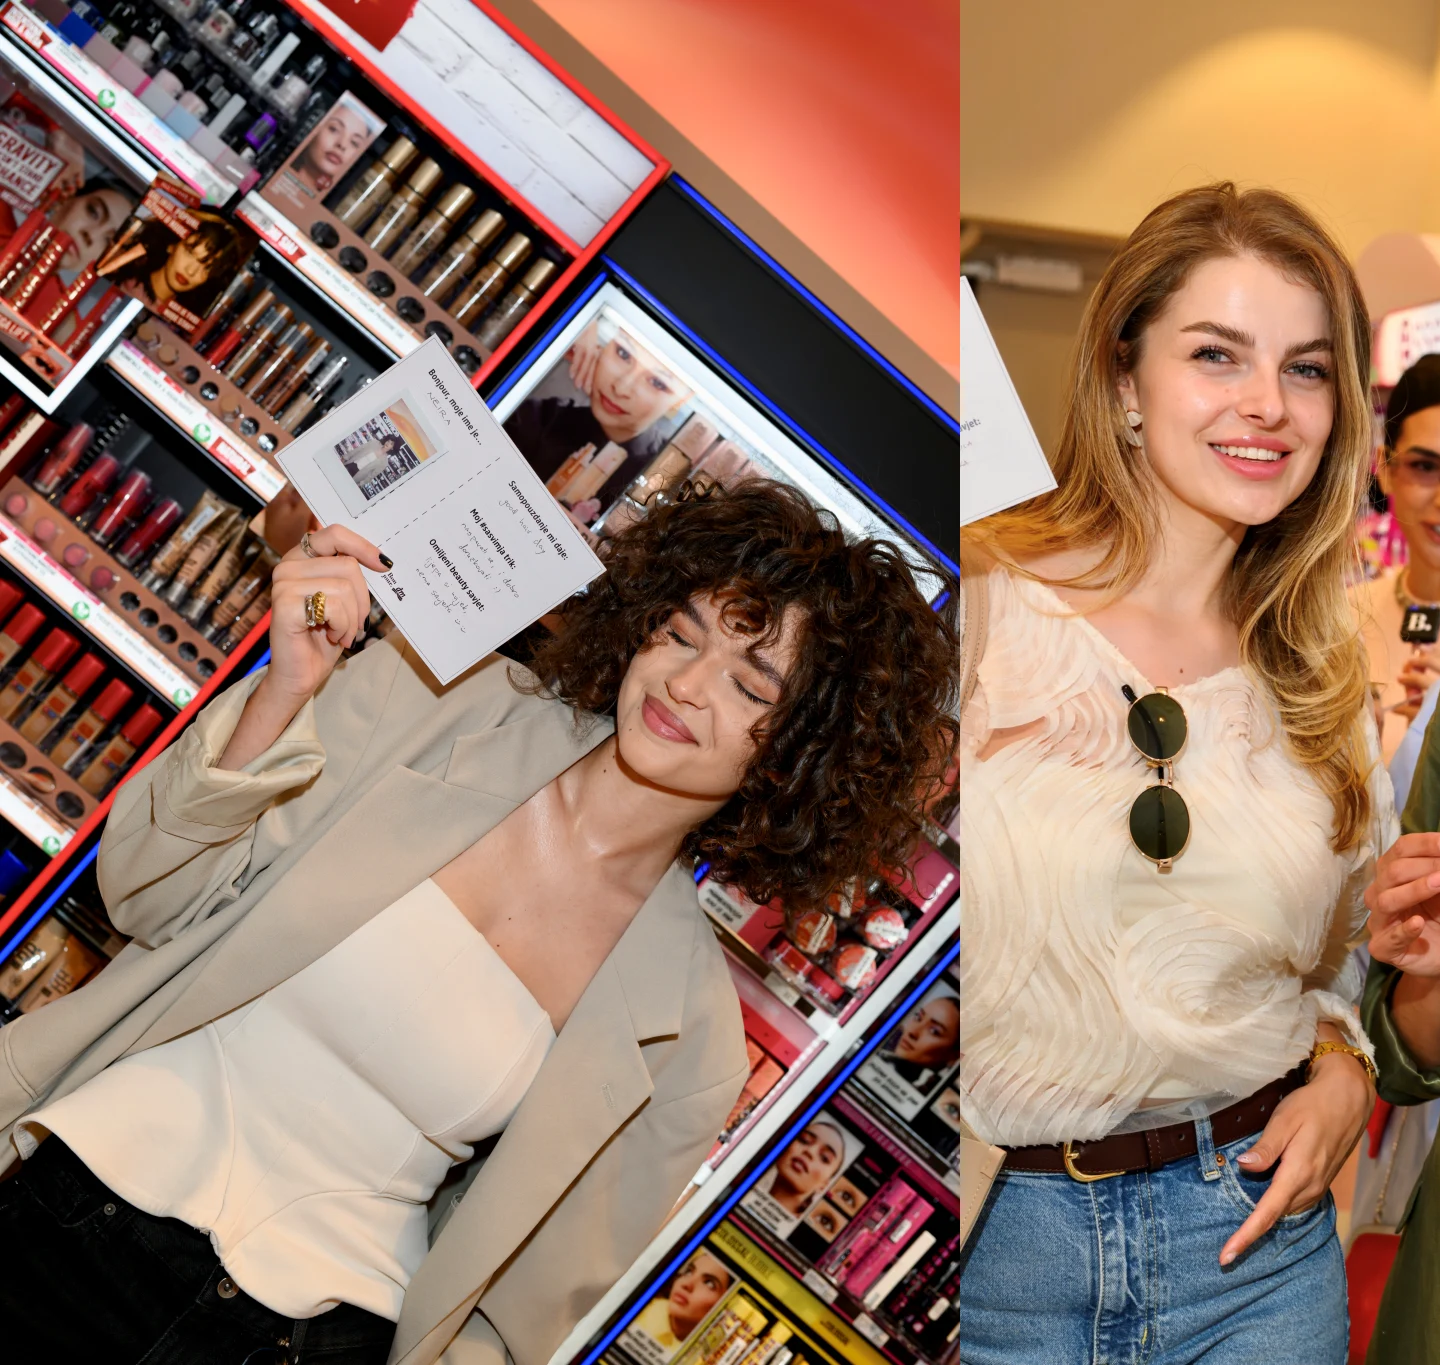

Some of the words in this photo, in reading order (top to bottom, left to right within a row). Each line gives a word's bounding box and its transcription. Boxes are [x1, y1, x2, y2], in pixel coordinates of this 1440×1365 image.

[0, 161, 34, 190] HANCE
[427, 392, 450, 425] NEIRA
[428, 369, 450, 399] Bonjour,
[449, 399, 463, 416] moje
[462, 416, 473, 430] ime
[470, 429, 481, 445] je...
[960, 417, 981, 432] vjet:
[470, 509, 483, 523] Moj
[480, 523, 505, 555] #sasvimja
[504, 554, 515, 569] trik:
[499, 500, 518, 514] good
[520, 518, 531, 534] hair
[533, 539, 545, 554] day
[509, 481, 548, 533] Samopouzdanje
[547, 533, 557, 543] mi
[554, 543, 568, 560] daje:
[430, 539, 453, 567] Omiljeni
[450, 566, 469, 590] beauty
[466, 590, 484, 611] savjet:
[1408, 613, 1432, 632] B.
